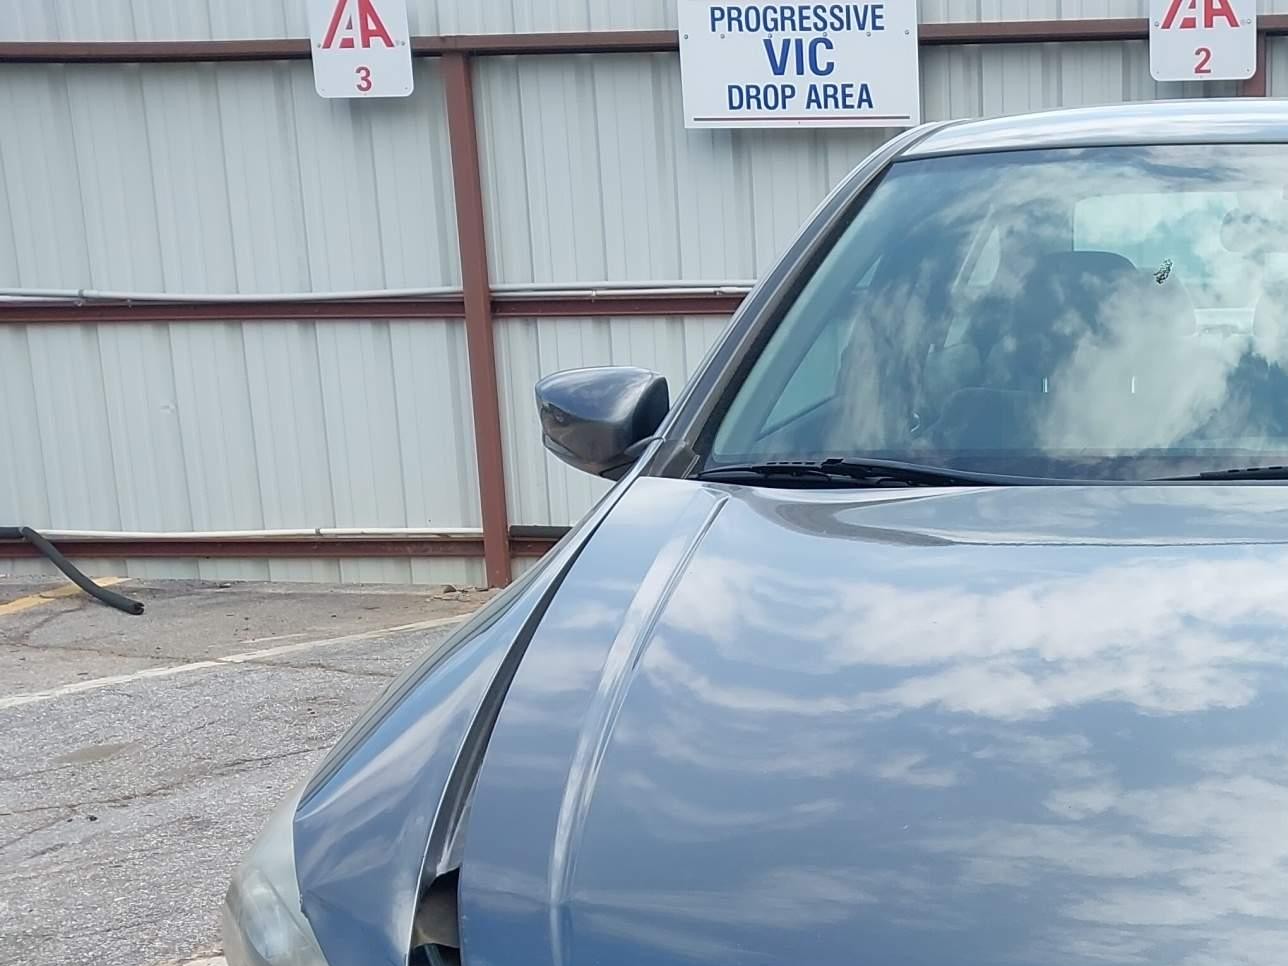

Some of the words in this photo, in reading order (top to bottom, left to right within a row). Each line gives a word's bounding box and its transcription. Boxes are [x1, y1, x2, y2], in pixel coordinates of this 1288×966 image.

[710, 4, 885, 33] PROGRESSIVE
[763, 37, 835, 76] VIC
[1194, 47, 1212, 74] 2
[355, 66, 372, 92] 3
[727, 84, 796, 111] DROP
[805, 83, 874, 110] AREA
